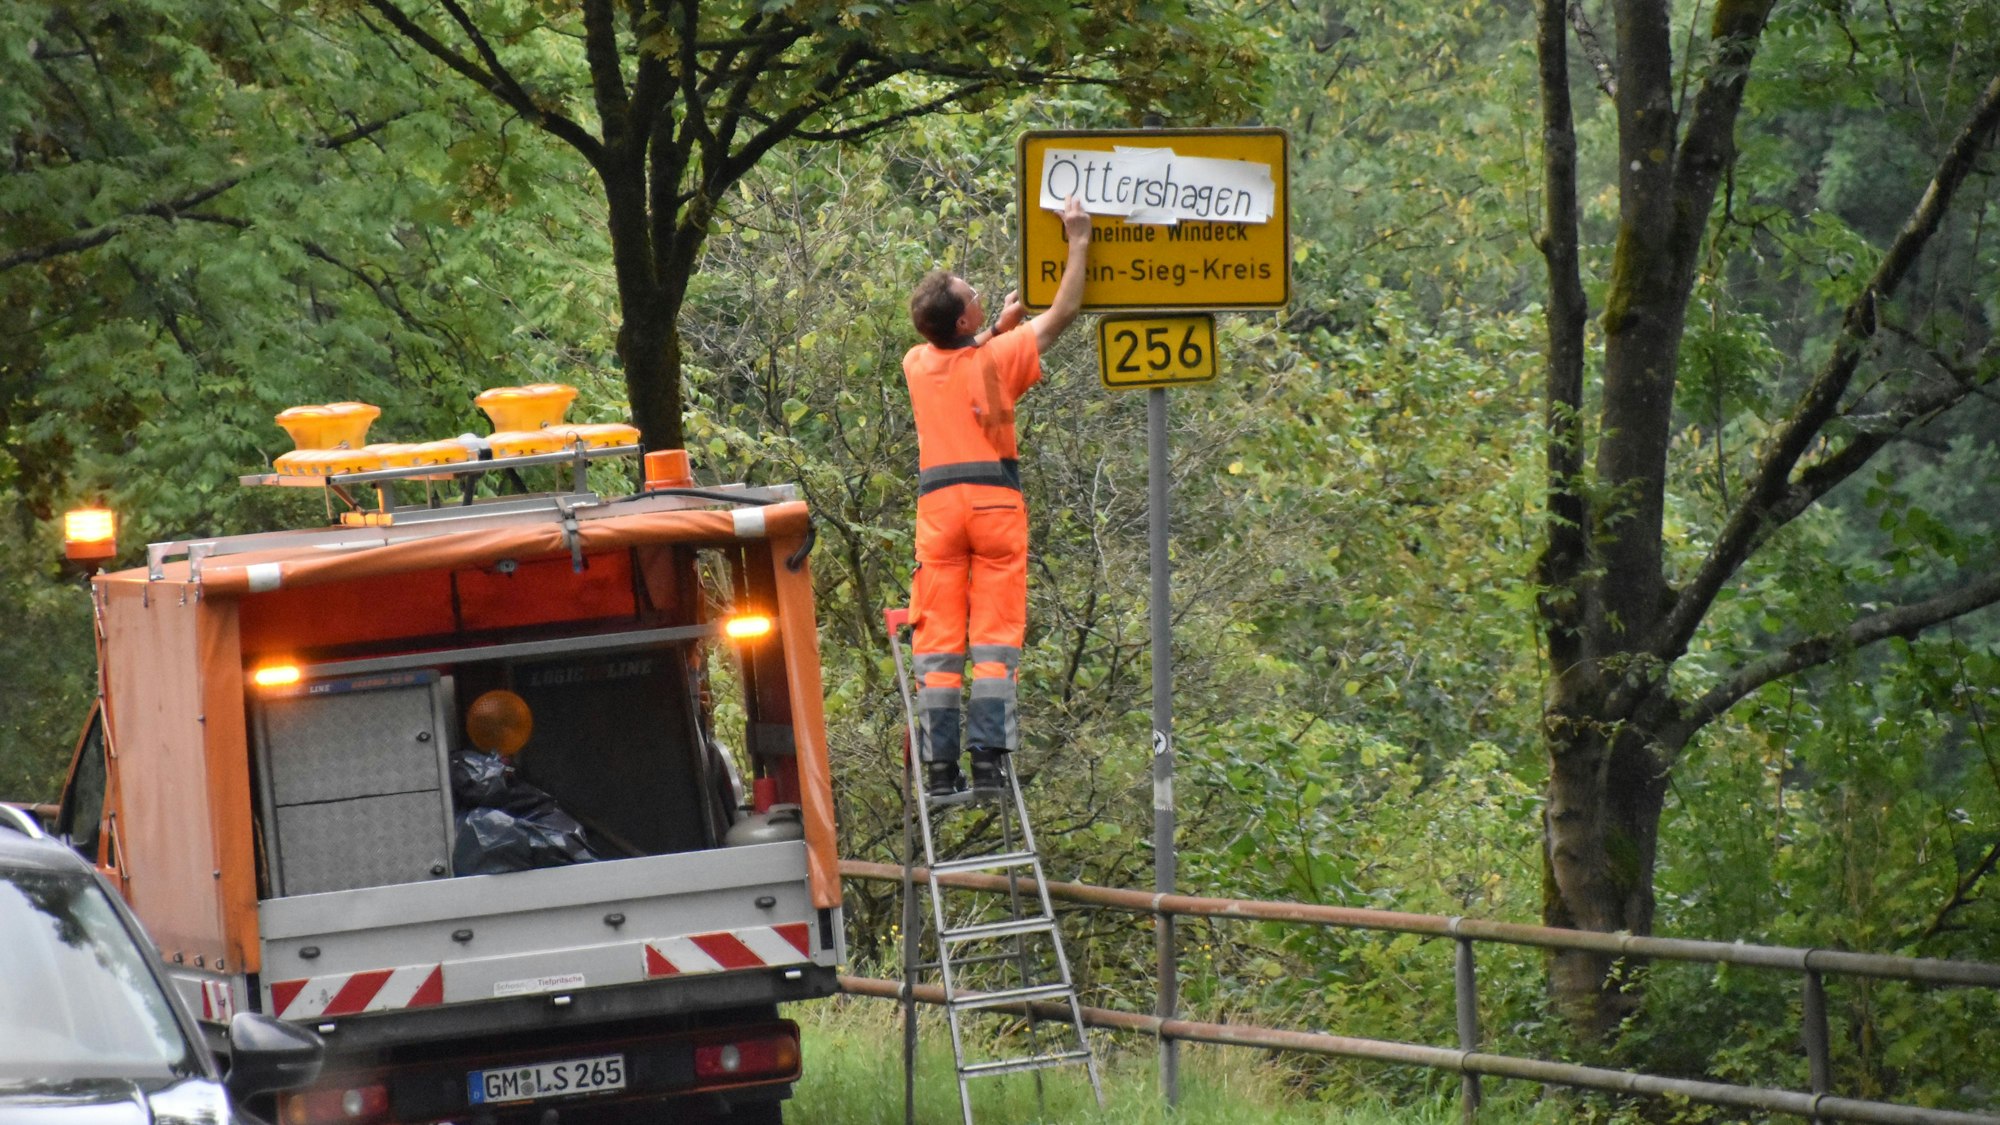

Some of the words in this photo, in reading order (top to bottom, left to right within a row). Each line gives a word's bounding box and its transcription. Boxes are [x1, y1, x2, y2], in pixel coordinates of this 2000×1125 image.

[1048, 154, 1251, 217] Öttershagen
[1167, 220, 1248, 241] Windeck
[1041, 257, 1271, 287] Rin-Sieg-Kreis
[1113, 325, 1203, 373] 256
[485, 1071, 519, 1098] GM
[536, 1066, 569, 1093] LS
[575, 1059, 621, 1089] 265
